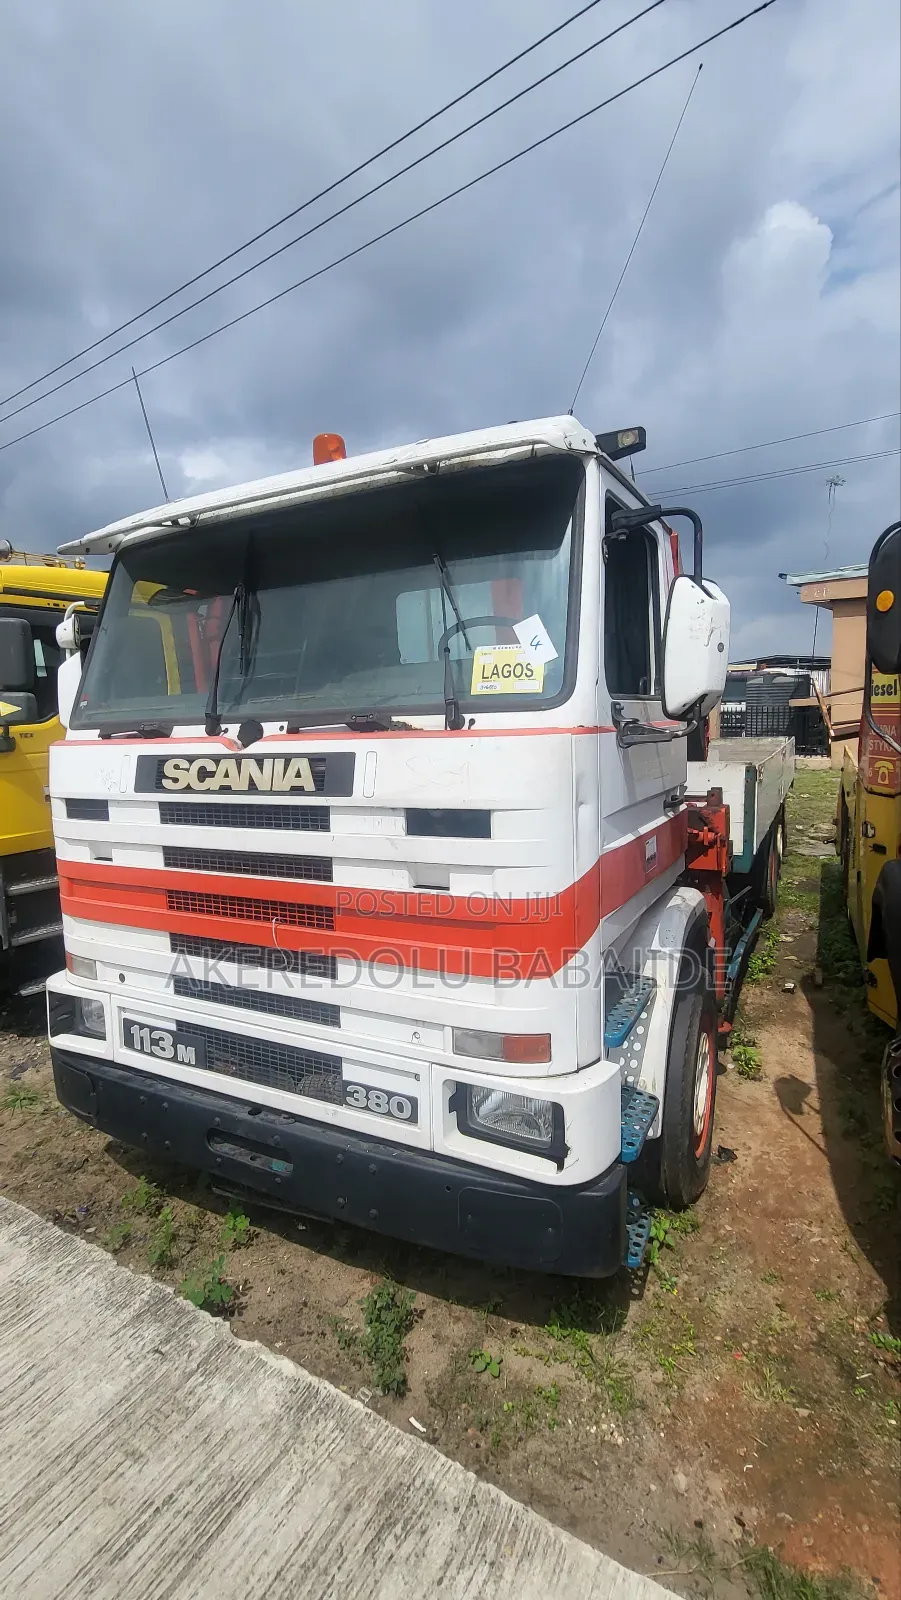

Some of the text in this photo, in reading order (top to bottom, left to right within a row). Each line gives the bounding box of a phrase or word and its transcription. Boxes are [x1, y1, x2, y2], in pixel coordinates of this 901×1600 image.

[529, 634, 543, 650] 4
[481, 662, 534, 680] LAGOS
[871, 678, 898, 697] iesel
[161, 757, 316, 792] SCANIA
[345, 1084, 413, 1120] 380
